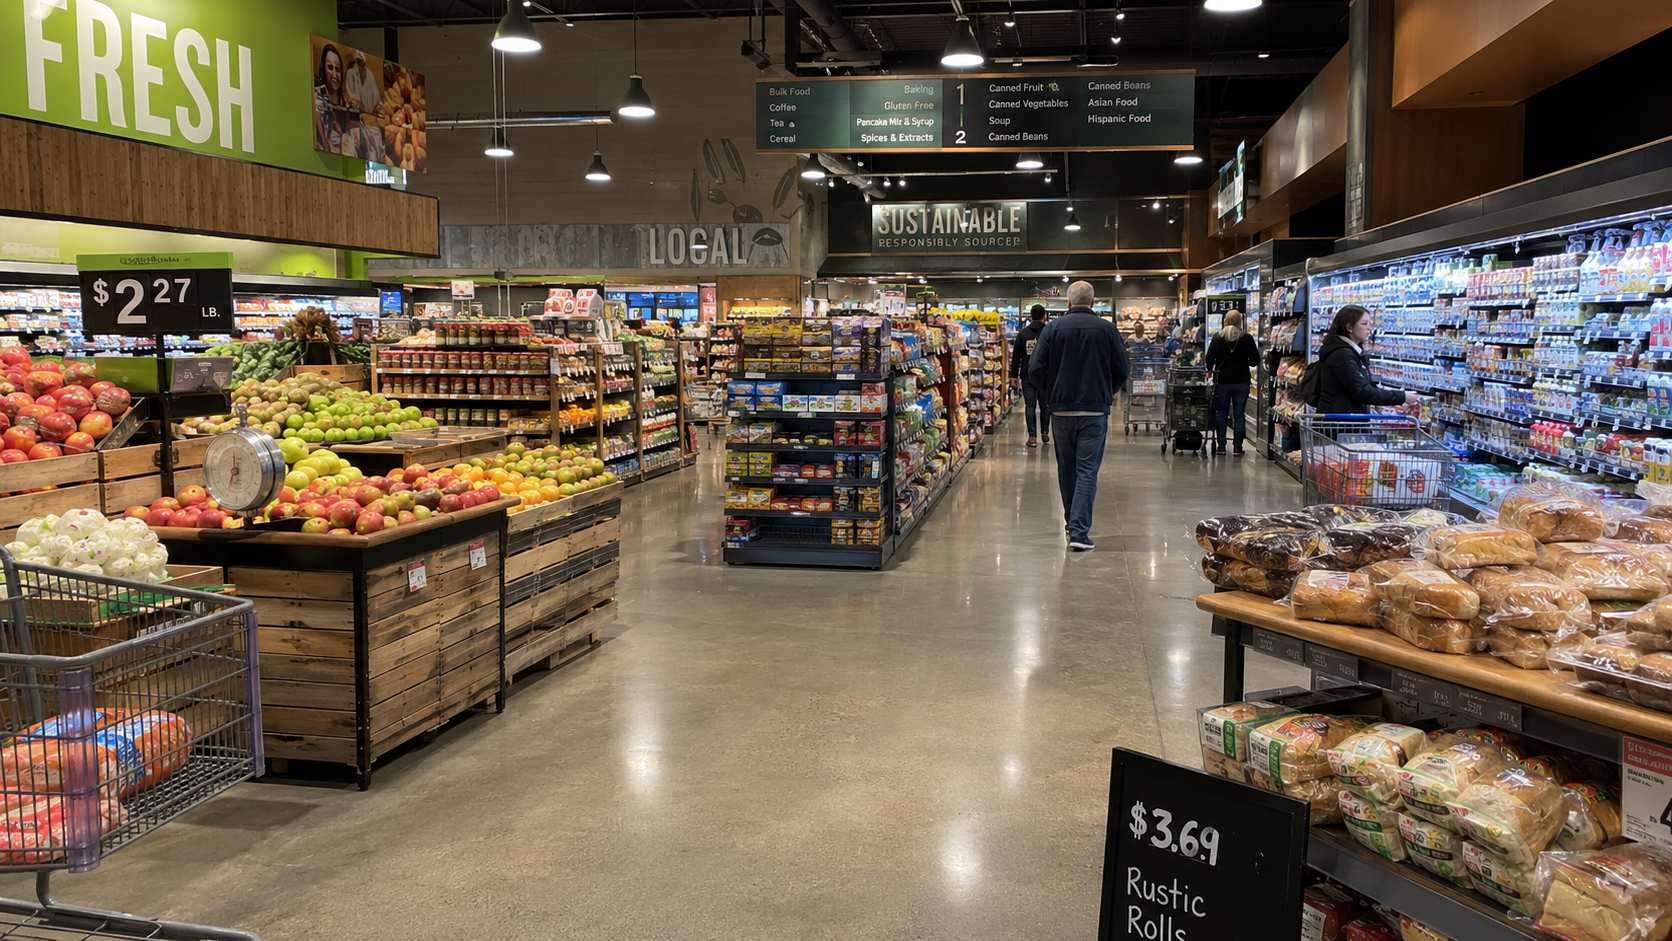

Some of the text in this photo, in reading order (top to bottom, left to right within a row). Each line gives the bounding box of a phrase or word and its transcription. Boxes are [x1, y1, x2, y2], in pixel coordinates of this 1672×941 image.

[23, 0, 254, 154] FRESH
[769, 87, 811, 96] Bulk Food
[903, 84, 935, 96] Baking
[988, 82, 1044, 93] Canned Fruit
[1087, 80, 1151, 91] Canned Beans
[956, 83, 966, 105] 1
[769, 102, 797, 112] Coffee
[914, 100, 935, 110] Free
[988, 98, 1069, 110] Canned Vegetables
[1087, 96, 1139, 107] Asian Food
[769, 118, 785, 128] Tea
[911, 116, 935, 128] Syrup
[988, 116, 1011, 127] Soup
[1087, 113, 1152, 125] Hispanic Food
[769, 134, 797, 144] Cereal
[860, 133, 889, 144] Spices
[898, 132, 935, 143] Extracts
[954, 130, 967, 145] 2
[988, 131, 1049, 142] Canned Beans
[877, 206, 1022, 235] SUSTAINABLE
[649, 227, 748, 265] LOCAL
[202, 307, 221, 318] LB.
[1127, 866, 1207, 918] Rustic
[1127, 904, 1187, 941] Rolls
